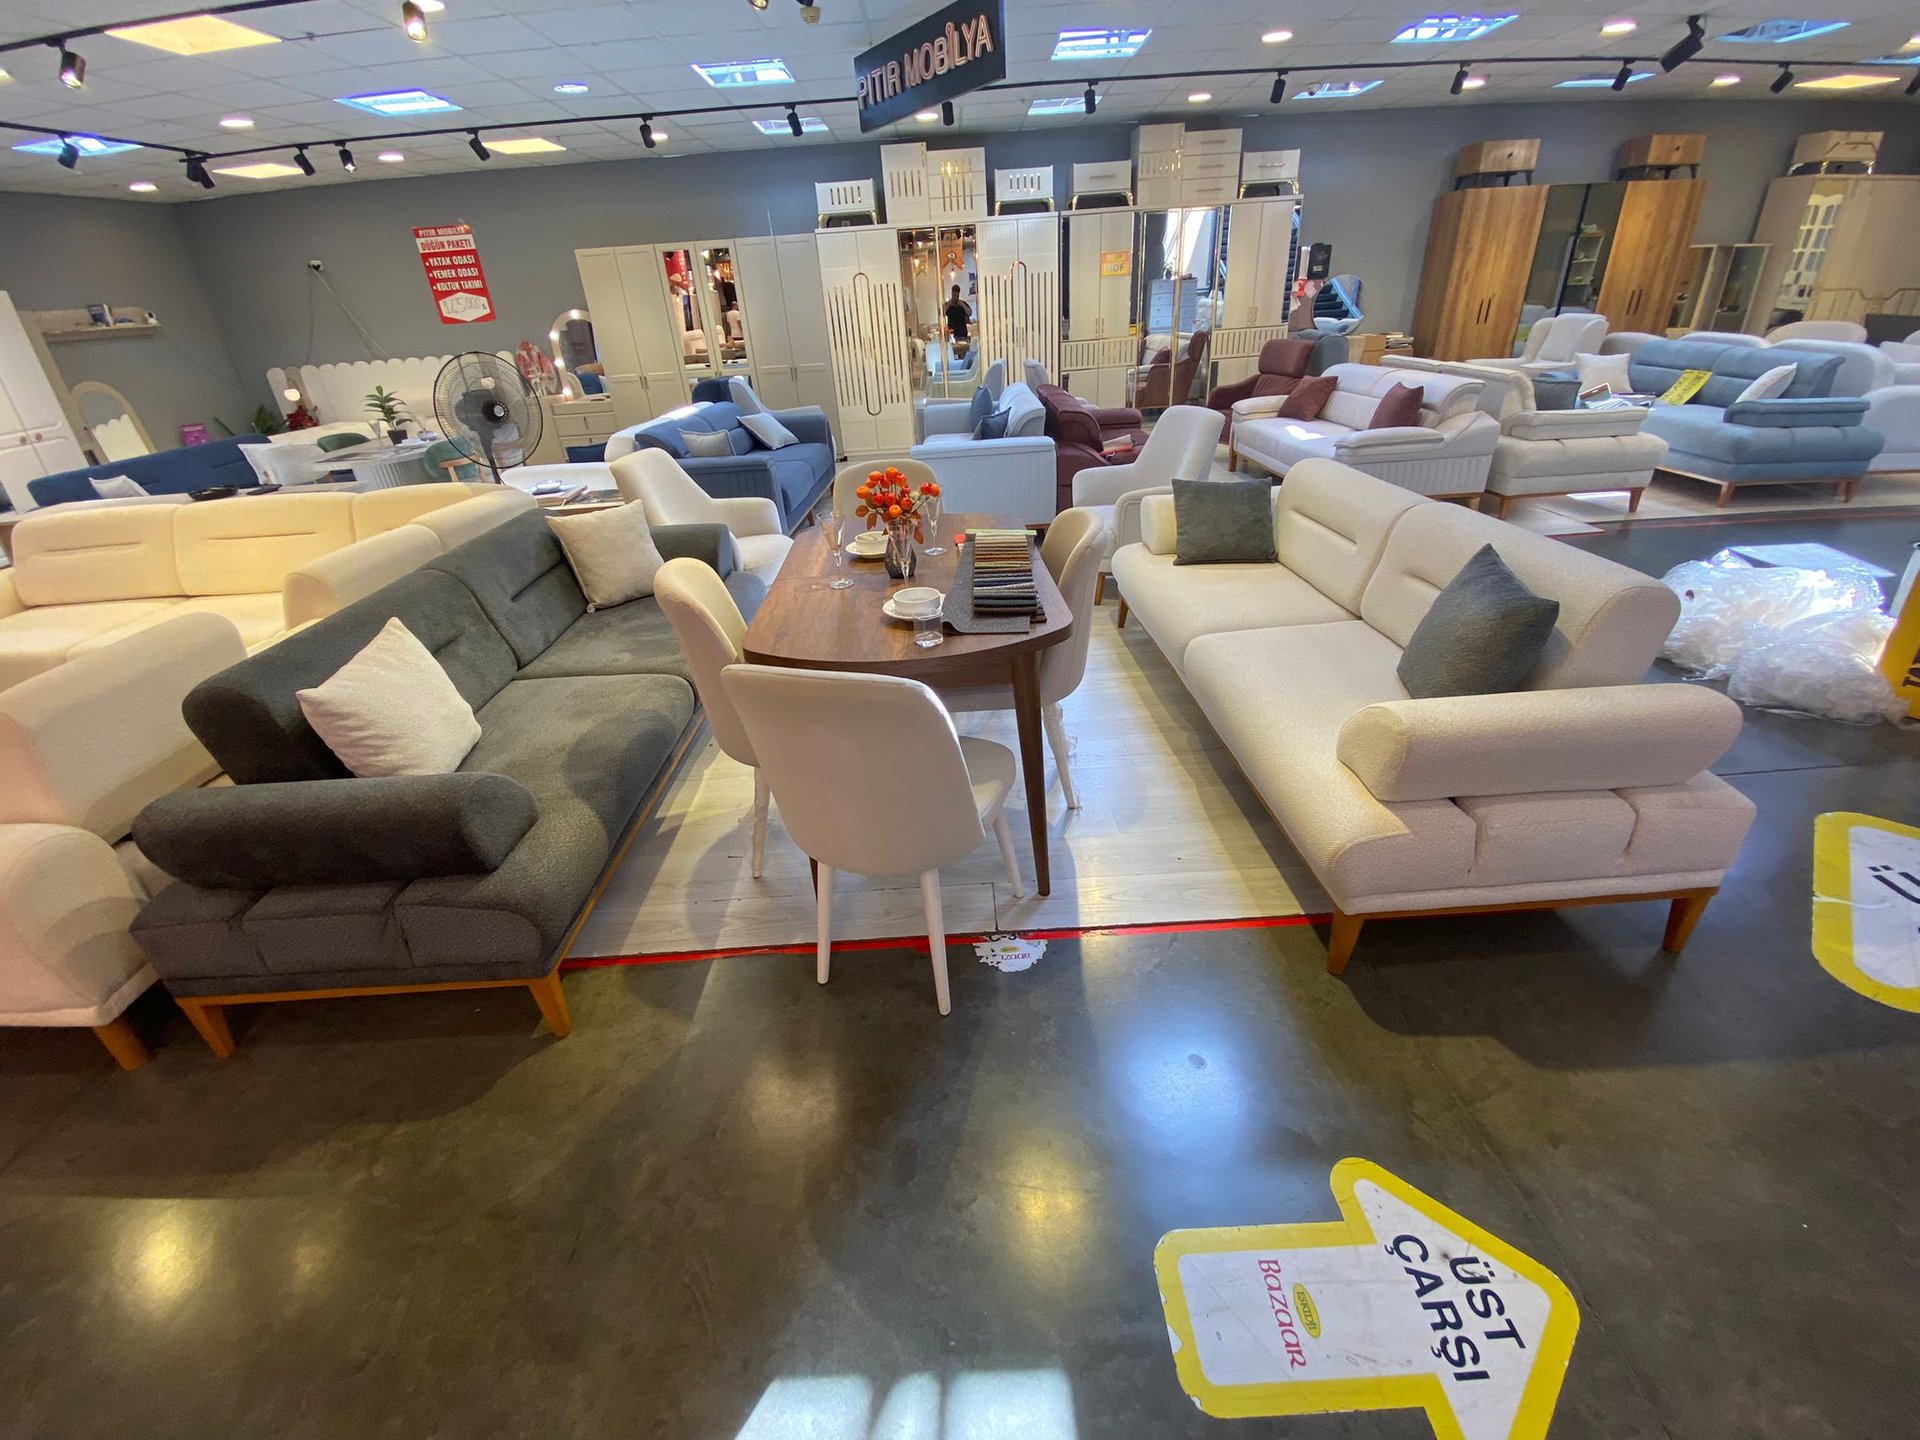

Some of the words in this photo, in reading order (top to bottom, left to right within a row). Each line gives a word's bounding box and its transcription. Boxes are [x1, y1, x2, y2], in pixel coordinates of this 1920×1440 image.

[857, 60, 901, 110] PITIR
[903, 14, 994, 88] MOBİLYA
[428, 257, 452, 267] YATAK
[452, 255, 475, 265] ODASI
[432, 269, 457, 279] YEMEK
[457, 267, 479, 277] ODASI
[436, 281, 460, 291] KOLTUK
[1384, 1234, 1490, 1381] ÇARŞI
[1449, 1256, 1526, 1349] ÜST
